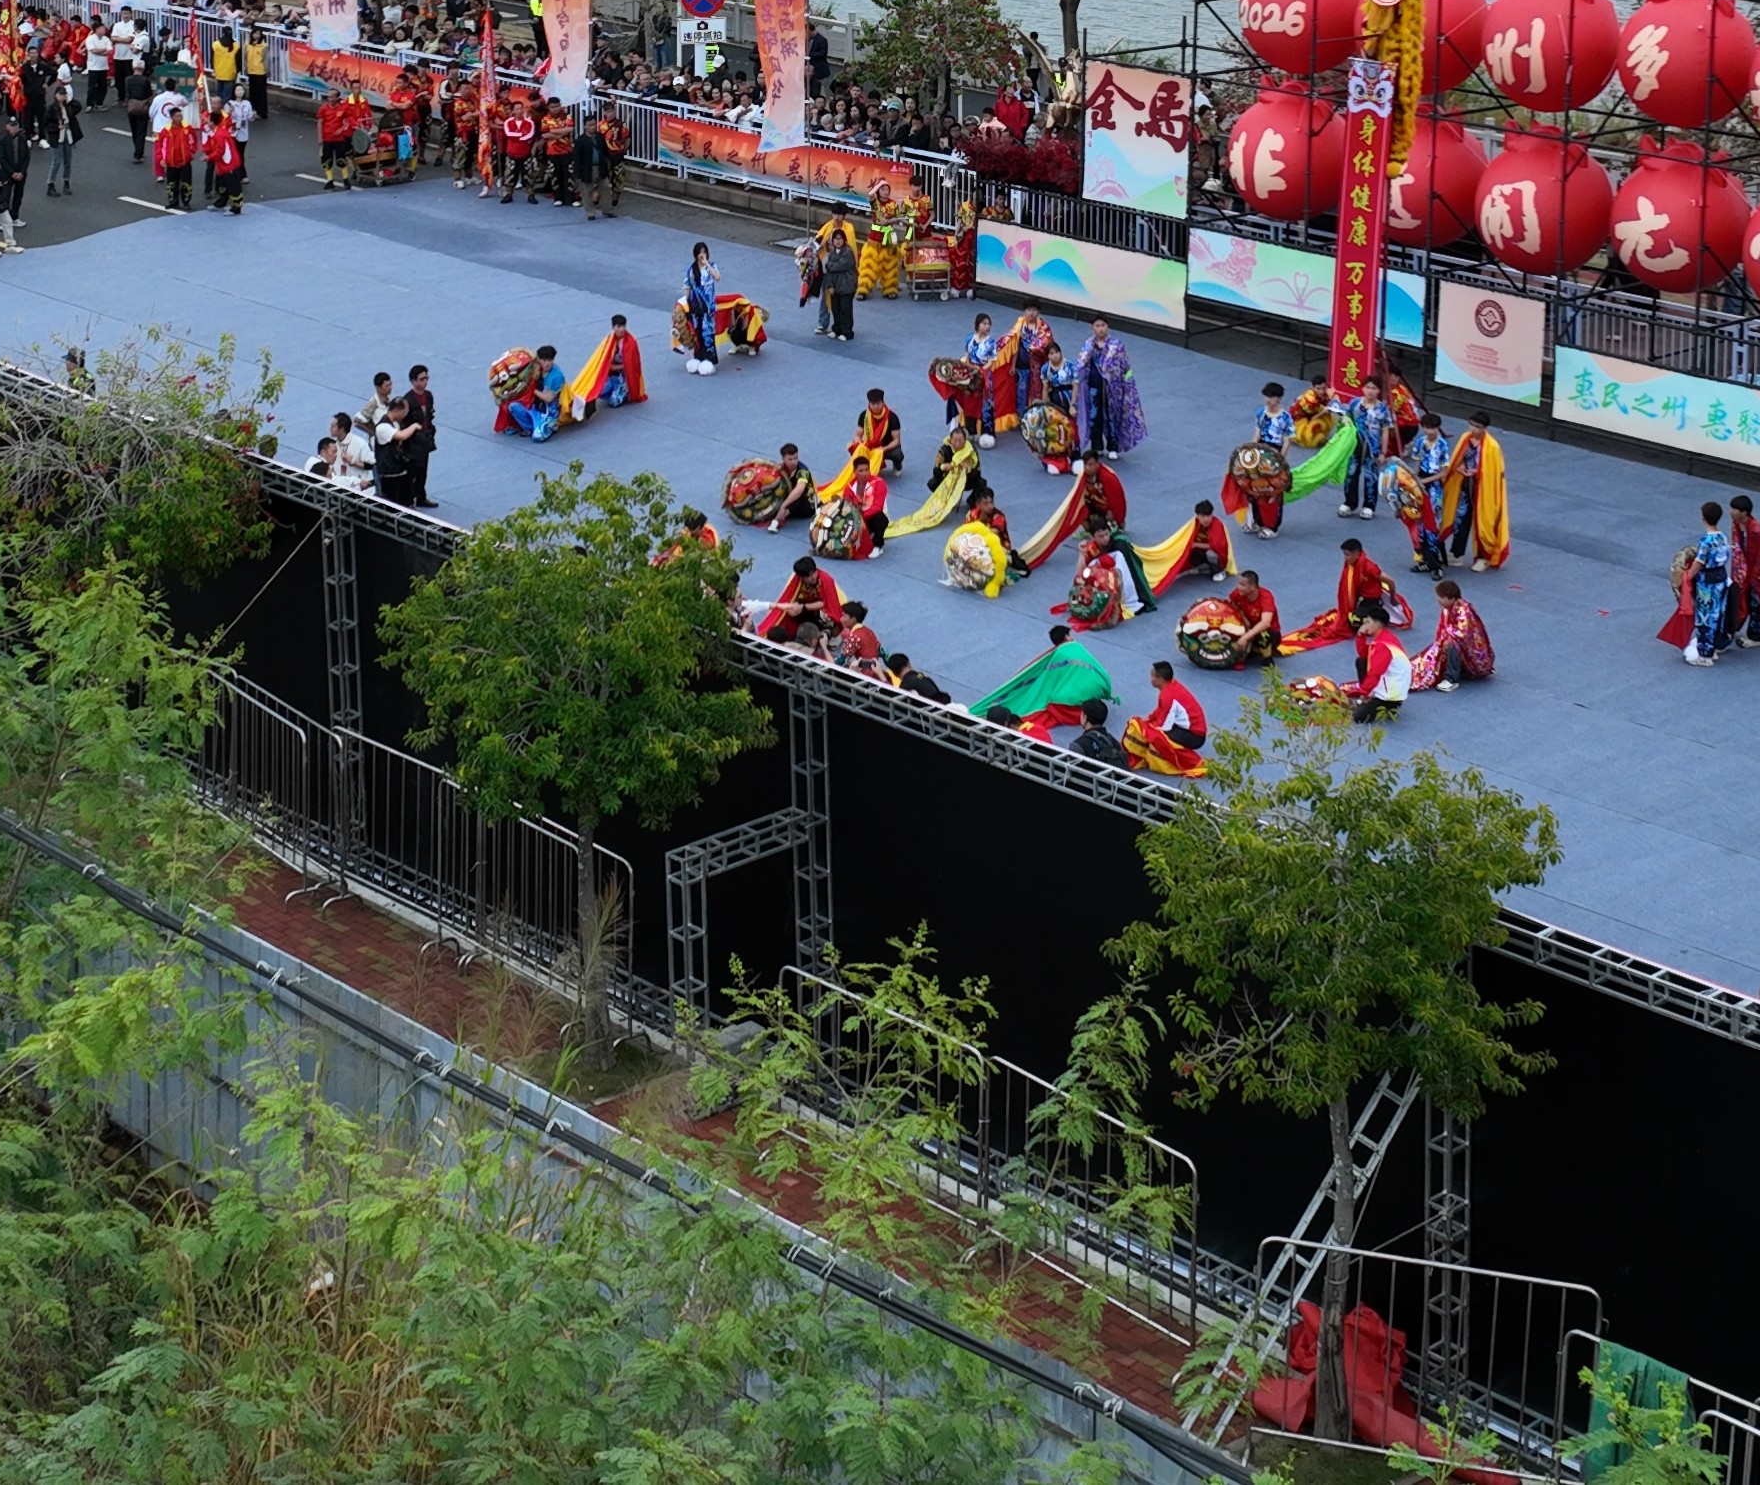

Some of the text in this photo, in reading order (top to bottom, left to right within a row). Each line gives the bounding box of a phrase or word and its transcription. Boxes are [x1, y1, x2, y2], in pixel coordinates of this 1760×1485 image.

[1086, 68, 1191, 154] 金马
[677, 131, 768, 175] 惠民之州
[1340, 114, 1377, 389] 身体健康 万事如意
[1566, 368, 1688, 432] 惠民之州
